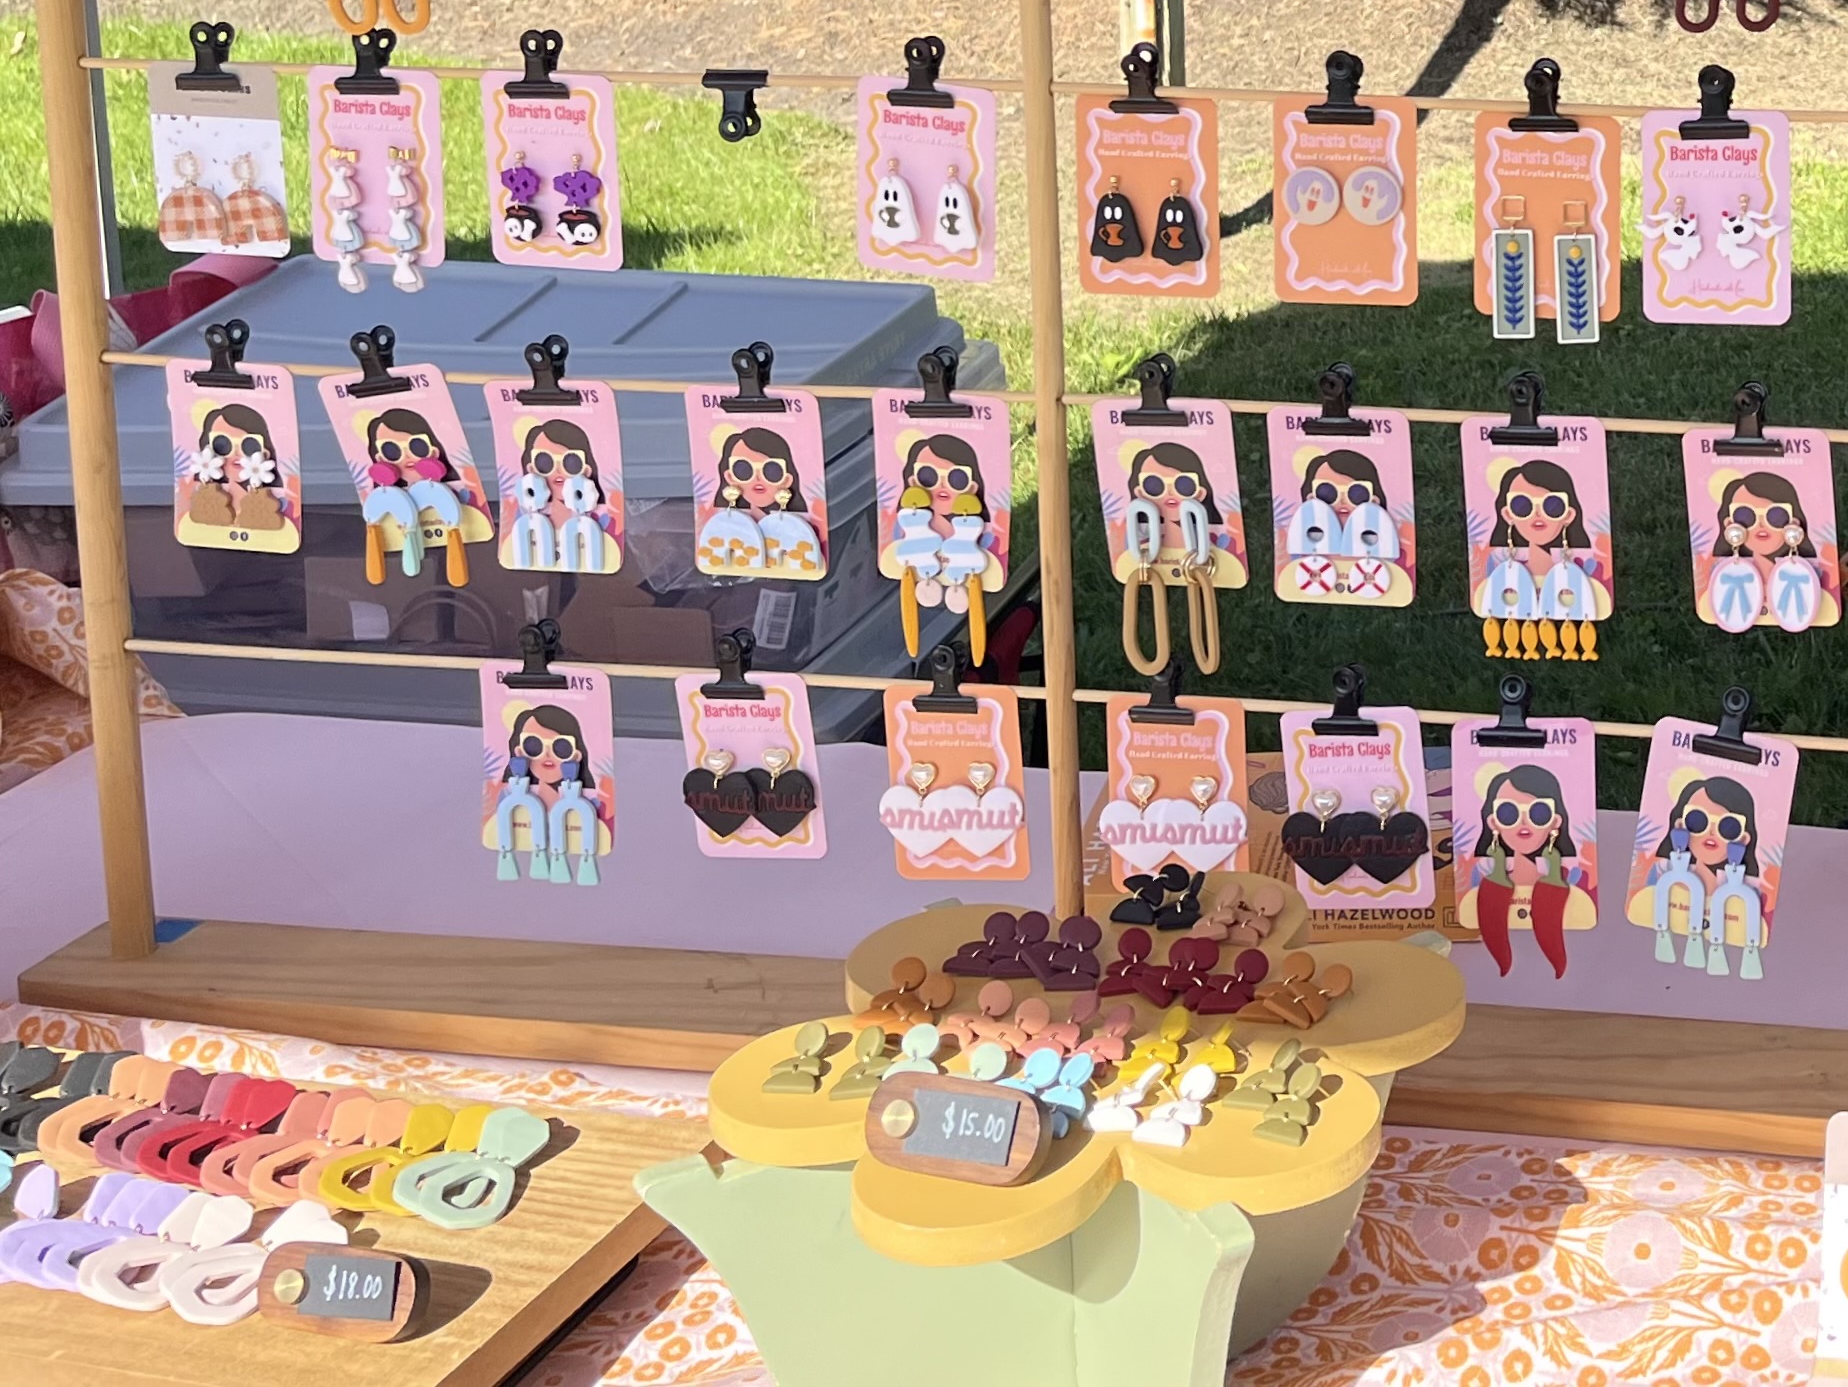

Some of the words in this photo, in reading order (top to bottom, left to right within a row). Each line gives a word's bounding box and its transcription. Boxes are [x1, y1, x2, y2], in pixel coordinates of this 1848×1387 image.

[334, 99, 376, 115] Barista
[380, 101, 411, 120] Clays
[508, 104, 551, 119] Barista
[555, 106, 586, 124] Clays
[884, 110, 928, 128] Barista
[932, 116, 966, 135] Clays
[1102, 129, 1147, 144] Barista
[1151, 131, 1184, 149] Clays
[1300, 132, 1344, 148] Barista
[1348, 134, 1382, 152] Clays
[1502, 148, 1548, 164] Barista
[1552, 151, 1586, 169] Clays
[1670, 145, 1717, 161] Barista
[1722, 146, 1757, 165] Clays
[704, 704, 746, 718] Barista
[750, 704, 781, 721] Clays
[1133, 732, 1176, 746] Barista
[1180, 733, 1212, 751] Clays
[1309, 744, 1353, 758] Barista
[1358, 742, 1390, 760] Clays
[936, 802, 1022, 831] smut
[1157, 816, 1246, 845] smut
[1324, 908, 1436, 921] HAZELWOOD
[1312, 922, 1332, 931] York
[1333, 922, 1357, 931] Times
[1359, 922, 1404, 931] Bestselling
[1406, 922, 1436, 930] Author
[942, 1101, 1005, 1143] $15.00
[323, 1264, 383, 1302] $18.00
